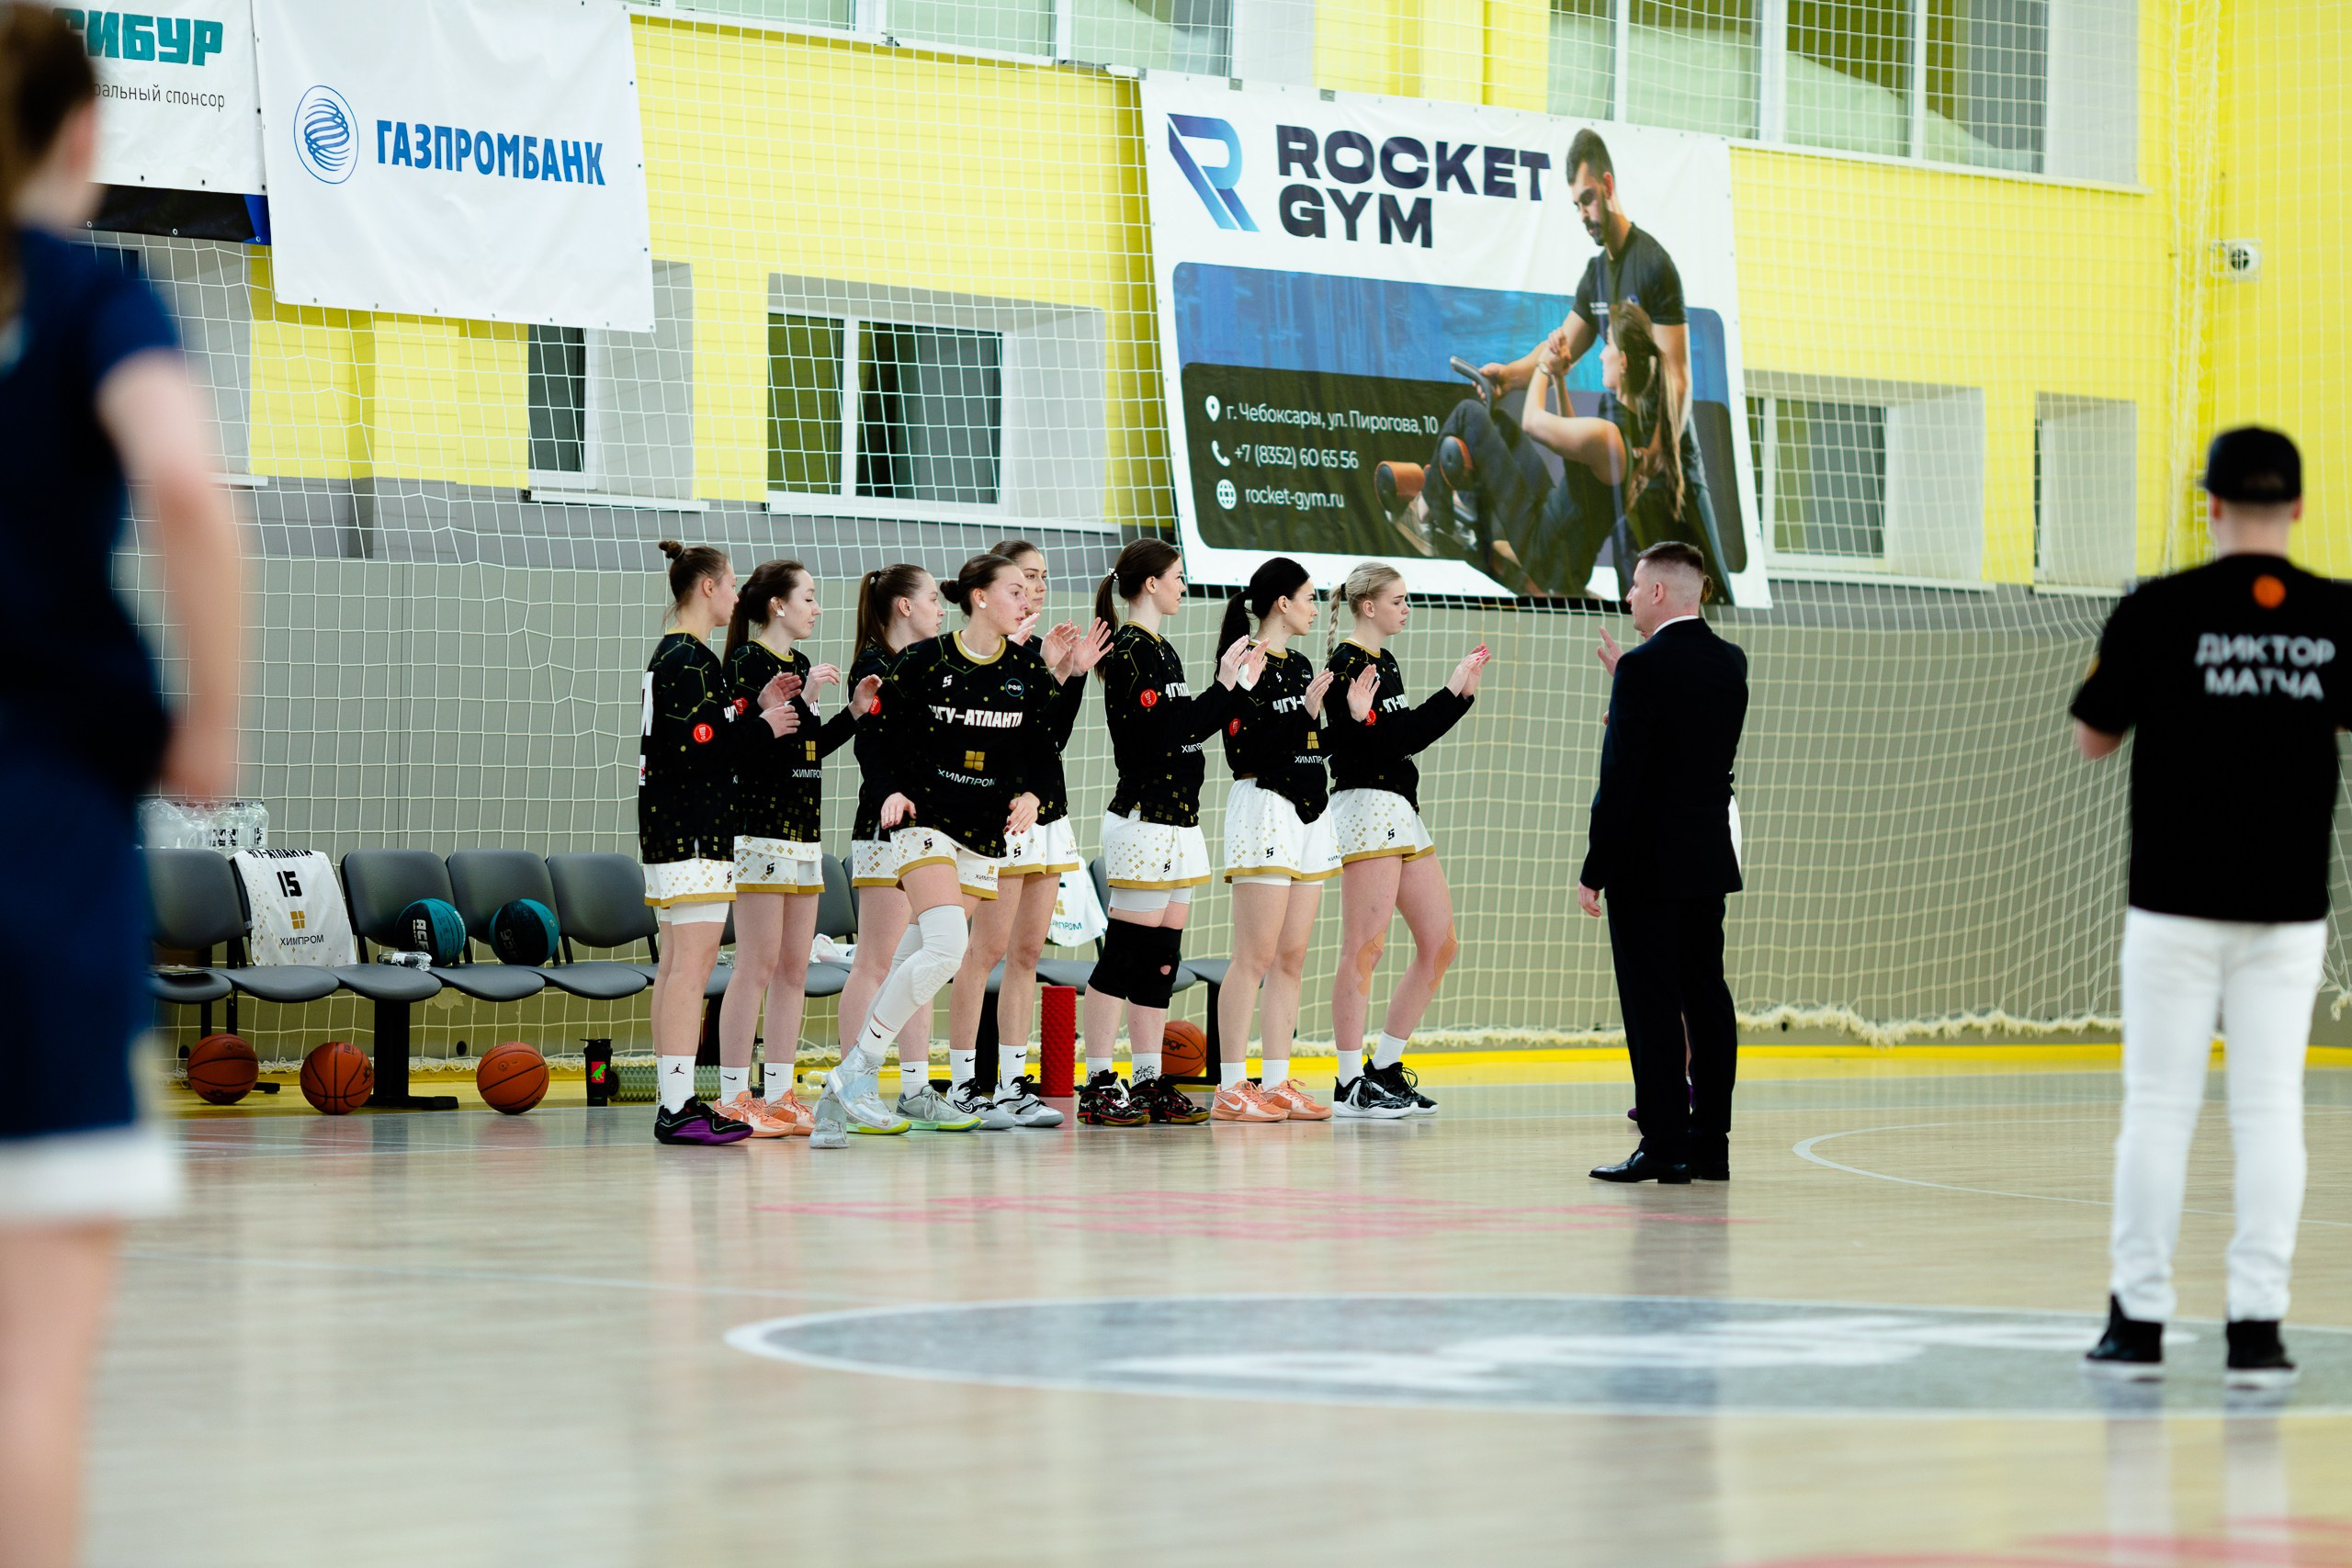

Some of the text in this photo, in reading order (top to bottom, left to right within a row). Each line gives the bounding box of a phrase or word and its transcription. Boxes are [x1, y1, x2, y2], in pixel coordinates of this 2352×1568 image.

[165, 89, 225, 112] спонсор
[377, 119, 606, 186] ГАЗПРОМБАНК
[1276, 124, 1551, 201] ROCKET
[1279, 184, 1432, 249] GYM
[1227, 402, 1439, 435] г. Чебоксары, ул. Пирогова, 10
[1234, 444, 1359, 469] +7 (8352) 60 65 56
[1245, 484, 1345, 511] rocket-gym.ru
[2194, 633, 2335, 667] ДИКТОР
[2205, 667, 2324, 701] МАТЧА
[277, 871, 302, 897] 15
[280, 934, 324, 946] ХИМПРОМ
